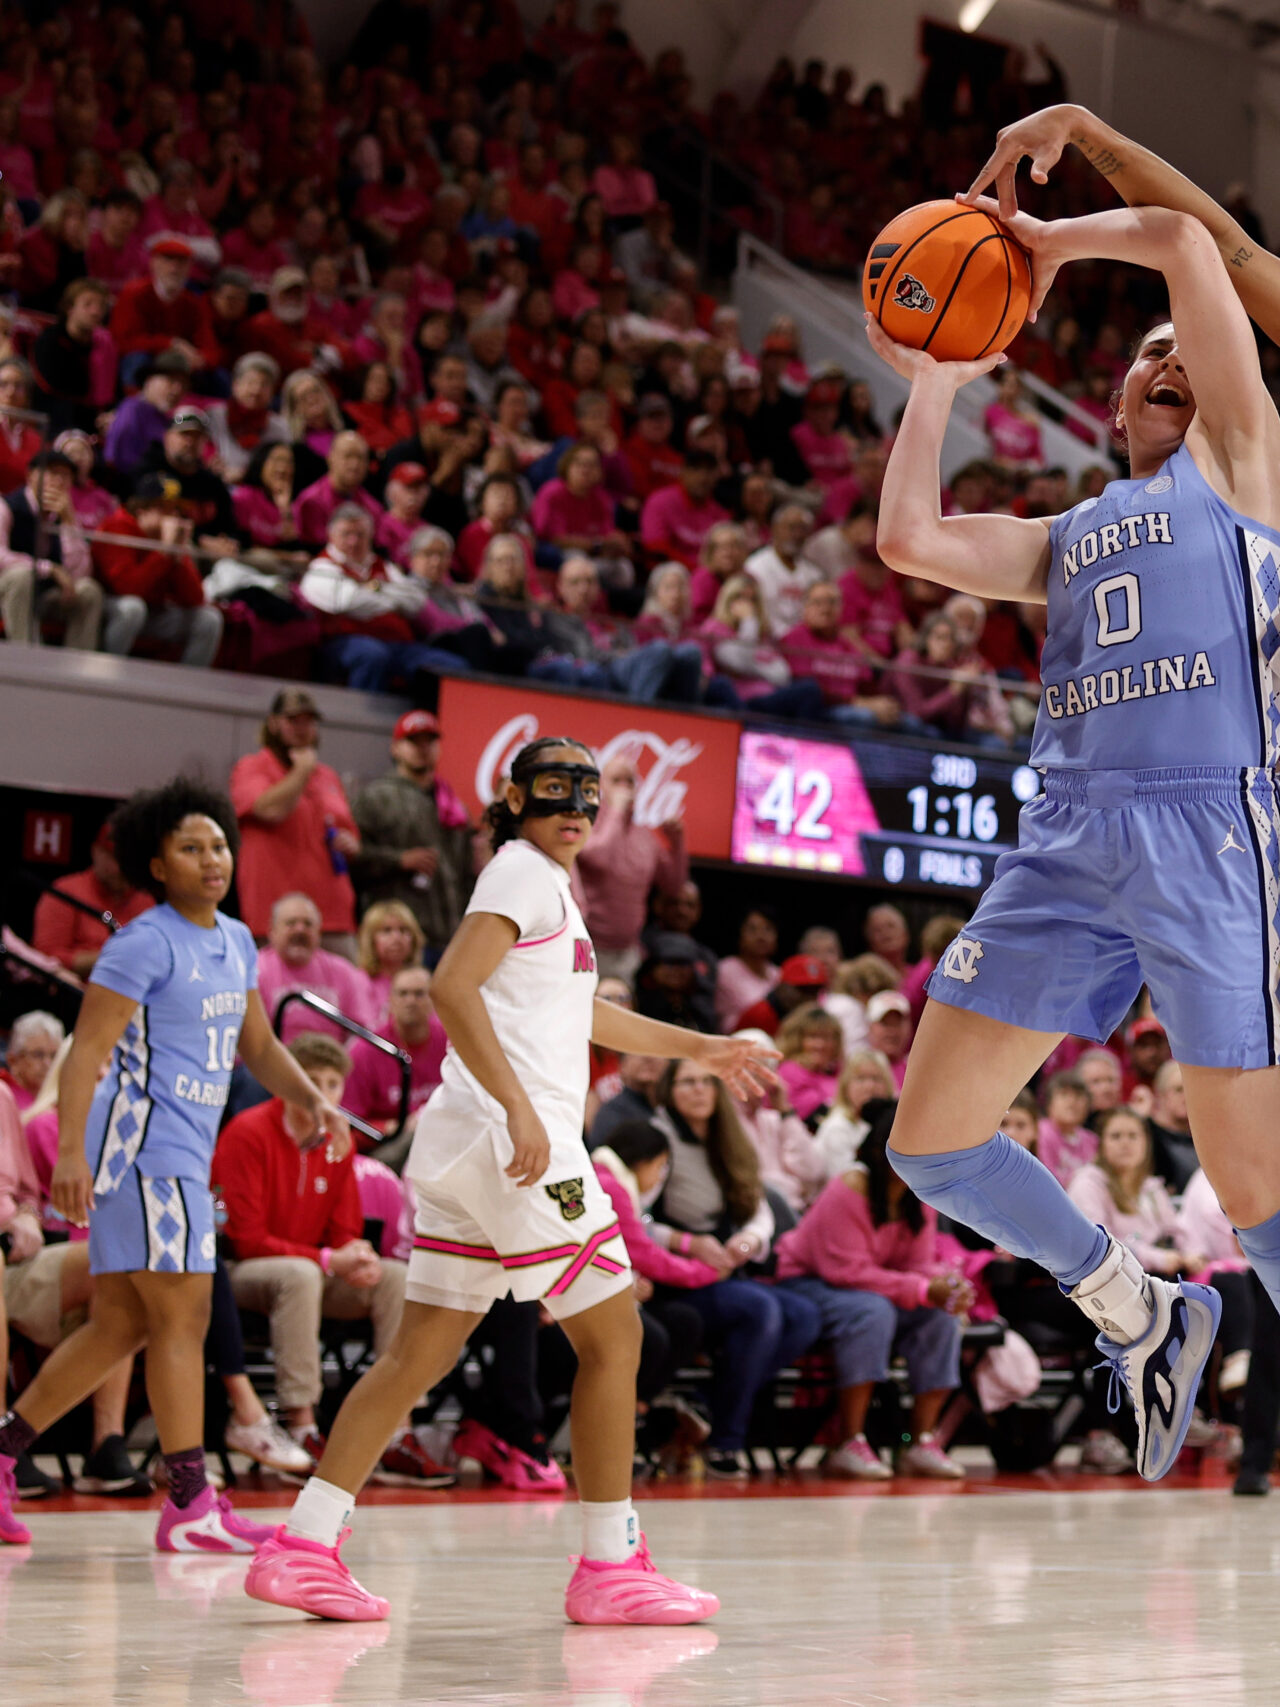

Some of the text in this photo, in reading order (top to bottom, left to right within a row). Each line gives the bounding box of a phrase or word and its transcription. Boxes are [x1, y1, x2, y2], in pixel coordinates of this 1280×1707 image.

[1062, 511, 1174, 588] NORTH
[1092, 571, 1142, 648] 0
[1045, 651, 1216, 719] CAROLINA
[756, 765, 833, 840] 42
[907, 785, 999, 842] 1:16
[34, 817, 61, 857] H
[206, 1026, 239, 1072] 10
